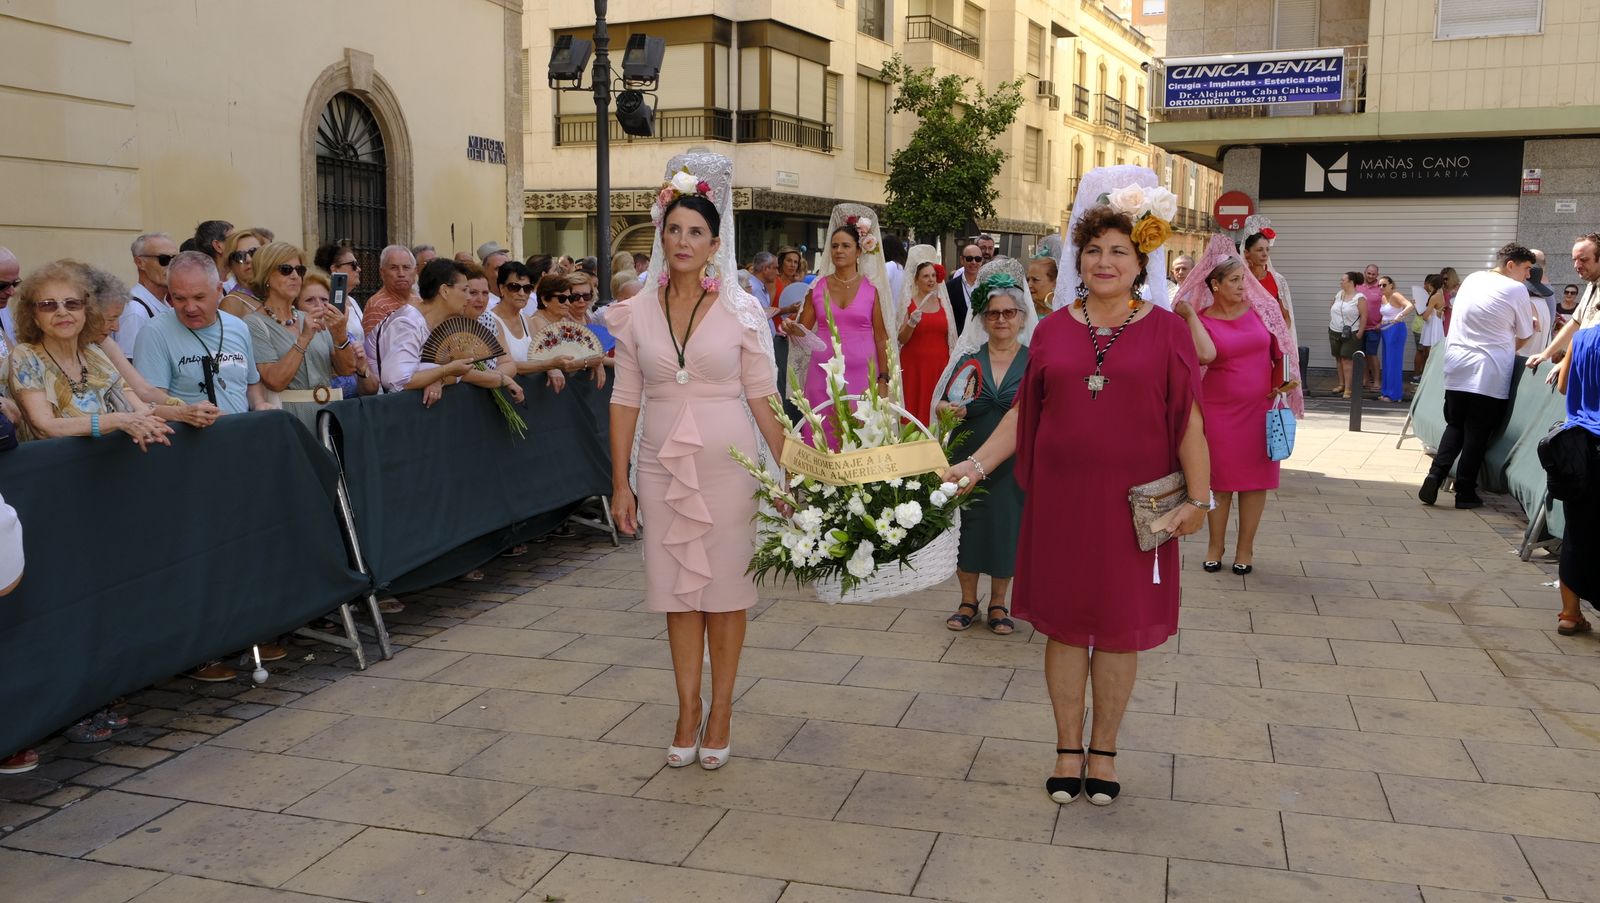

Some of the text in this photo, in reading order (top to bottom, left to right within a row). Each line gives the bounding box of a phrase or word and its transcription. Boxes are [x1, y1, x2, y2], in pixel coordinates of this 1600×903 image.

[1171, 58, 1337, 79] CLINICA DENTAL
[1209, 79, 1256, 89] Implantes
[1307, 74, 1340, 83] Dental
[1198, 89, 1247, 98] Alejandro
[1252, 87, 1278, 96] Caba
[1281, 85, 1329, 95] Calvache
[1169, 98, 1229, 107] ORTODONCIA
[468, 135, 505, 153] VIRGEN
[1360, 155, 1470, 170] MAÑAS CANO
[1359, 170, 1469, 180] INMOBILIARIA
[813, 456, 863, 471] HOMENAJE
[866, 455, 874, 465] A
[830, 462, 899, 480] ALMERIENSE
